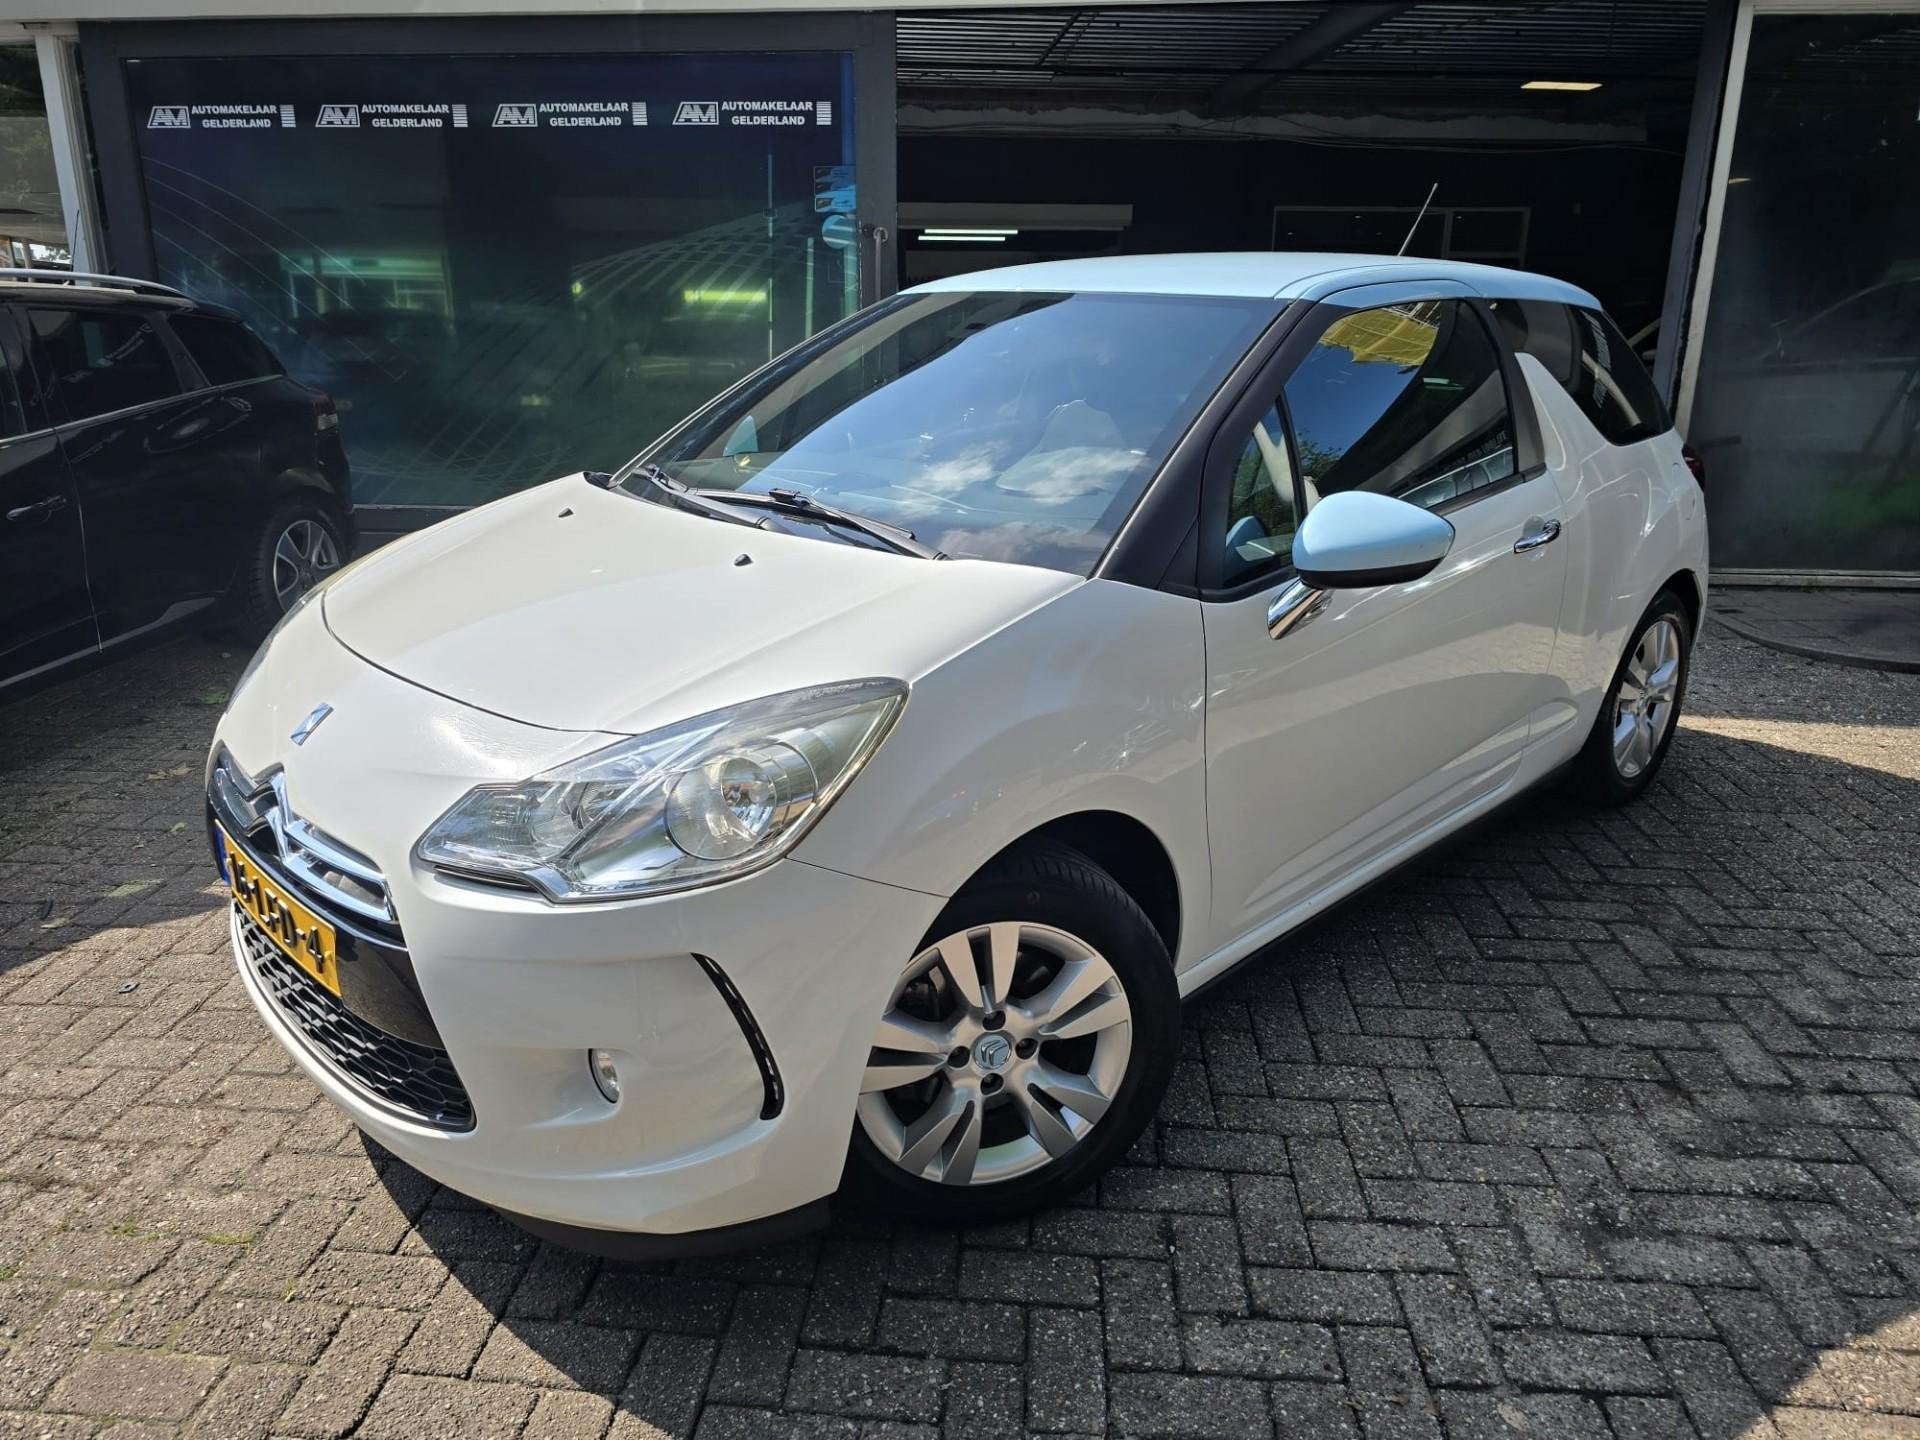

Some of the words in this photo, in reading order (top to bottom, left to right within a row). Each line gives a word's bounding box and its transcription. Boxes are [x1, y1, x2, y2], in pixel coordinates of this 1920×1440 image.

[191, 104, 277, 115] AUTOMAKELAAR
[361, 104, 450, 114] AUTOMAKELAAR
[539, 102, 630, 113] AUTOMAKELAAR
[721, 101, 814, 111] AUTOMAKELAAR
[150, 107, 189, 127] AM
[318, 106, 359, 126] AM
[495, 105, 537, 126] AM
[675, 103, 718, 124] AM
[202, 118, 272, 129] GELDERLAND
[371, 118, 443, 128] GELDERLAND
[549, 116, 622, 127] GELDERLAND
[731, 115, 805, 126] GELDERLAND
